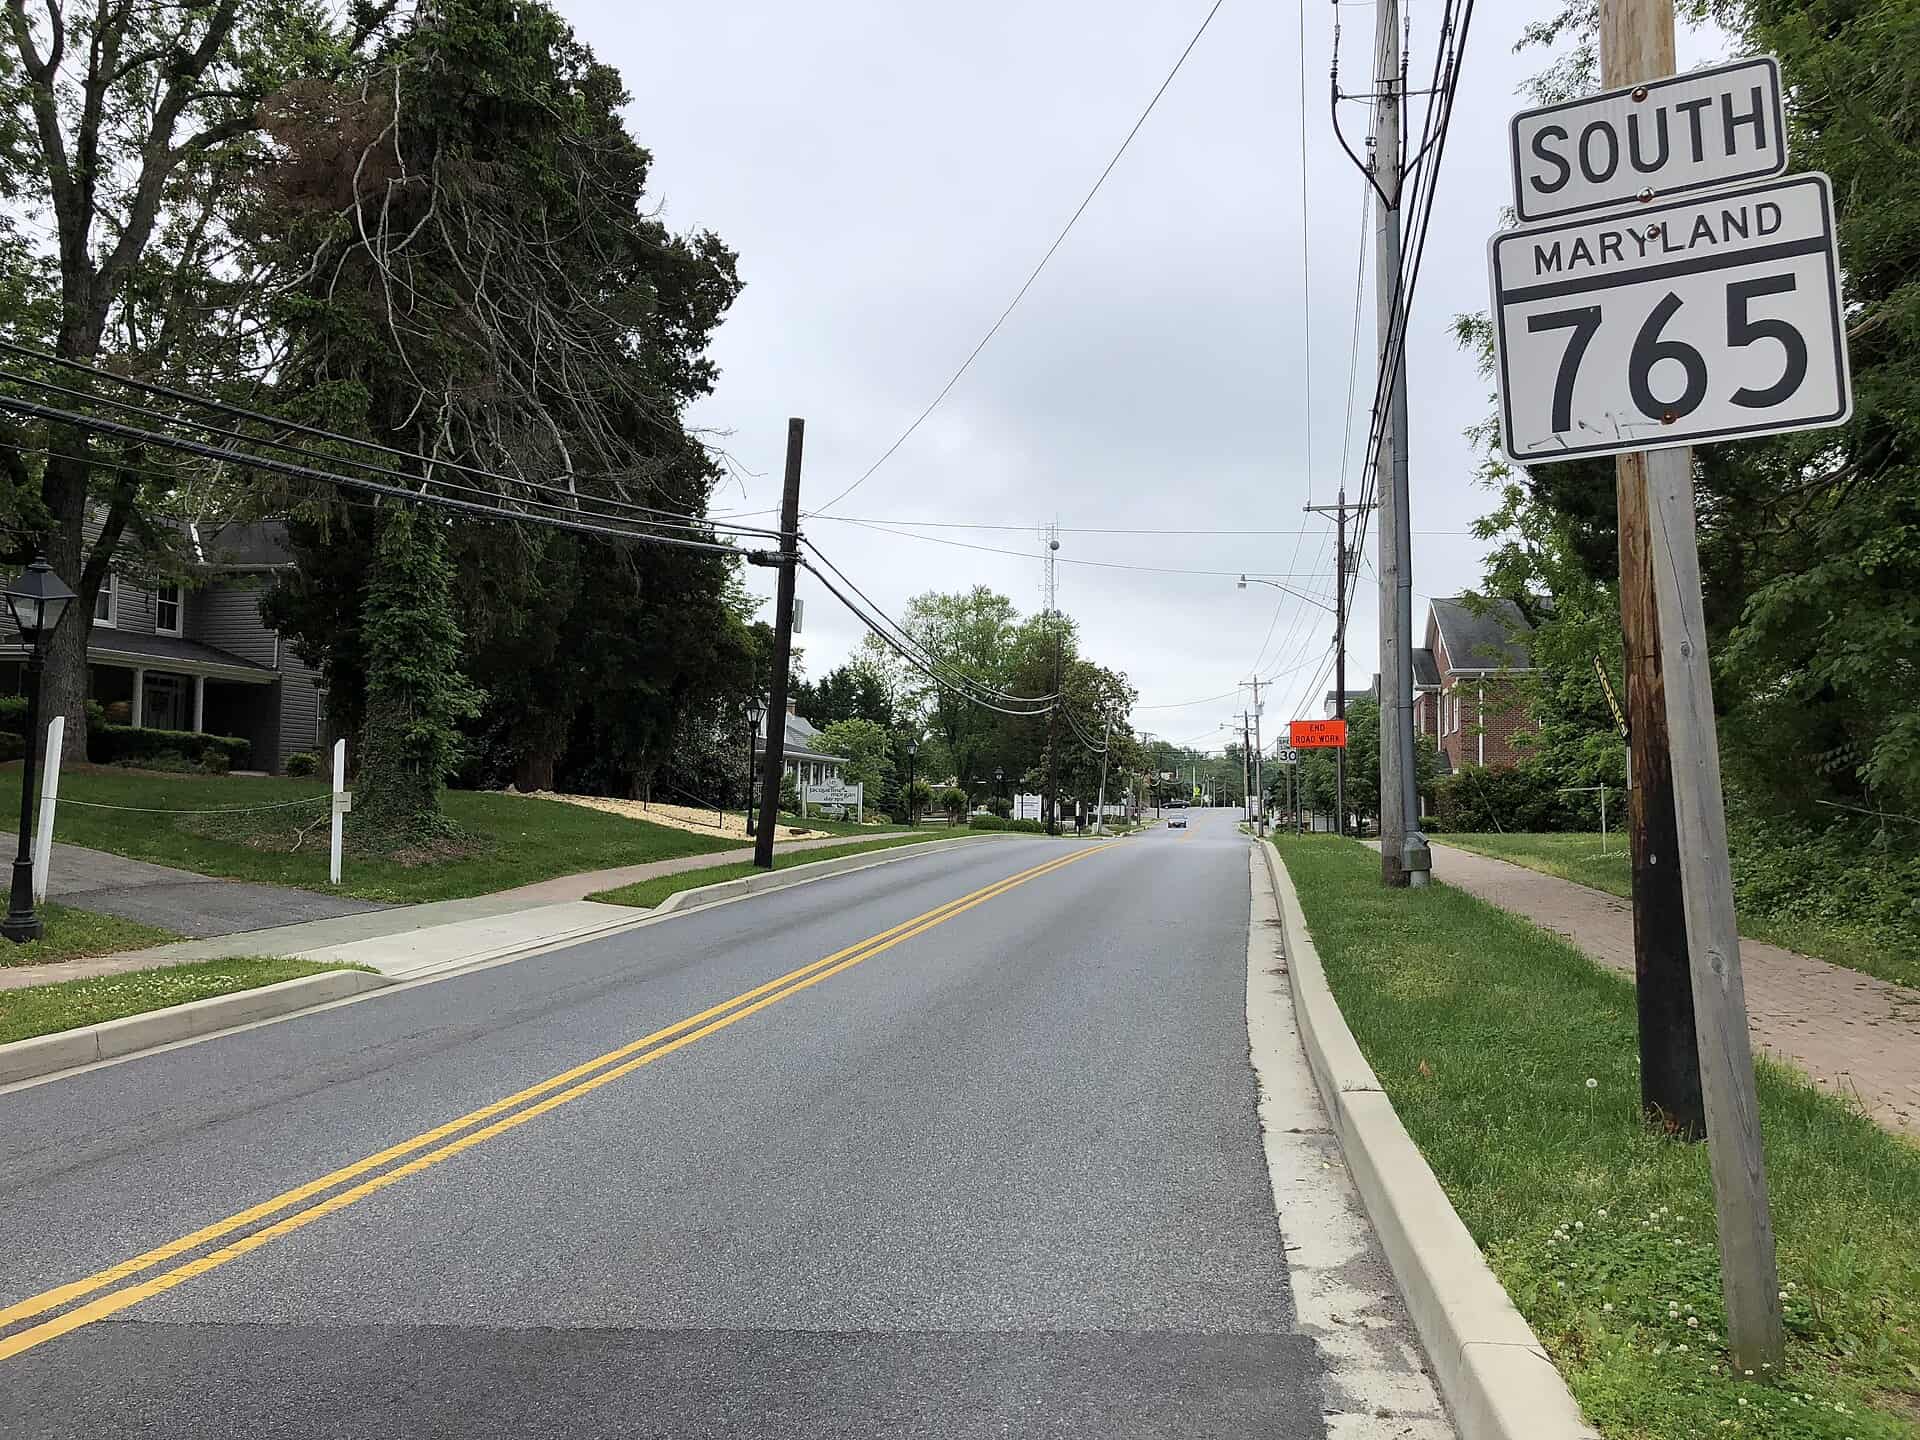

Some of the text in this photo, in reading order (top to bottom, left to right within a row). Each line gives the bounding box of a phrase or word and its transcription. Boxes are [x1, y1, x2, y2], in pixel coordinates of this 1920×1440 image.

[1530, 86, 1767, 194] SOUTH
[1535, 202, 1782, 276] MARYLAND
[1527, 272, 1808, 433] 765
[1296, 735, 1339, 744] ROAD WORK
[1310, 724, 1325, 732] END
[1280, 751, 1296, 761] 30
